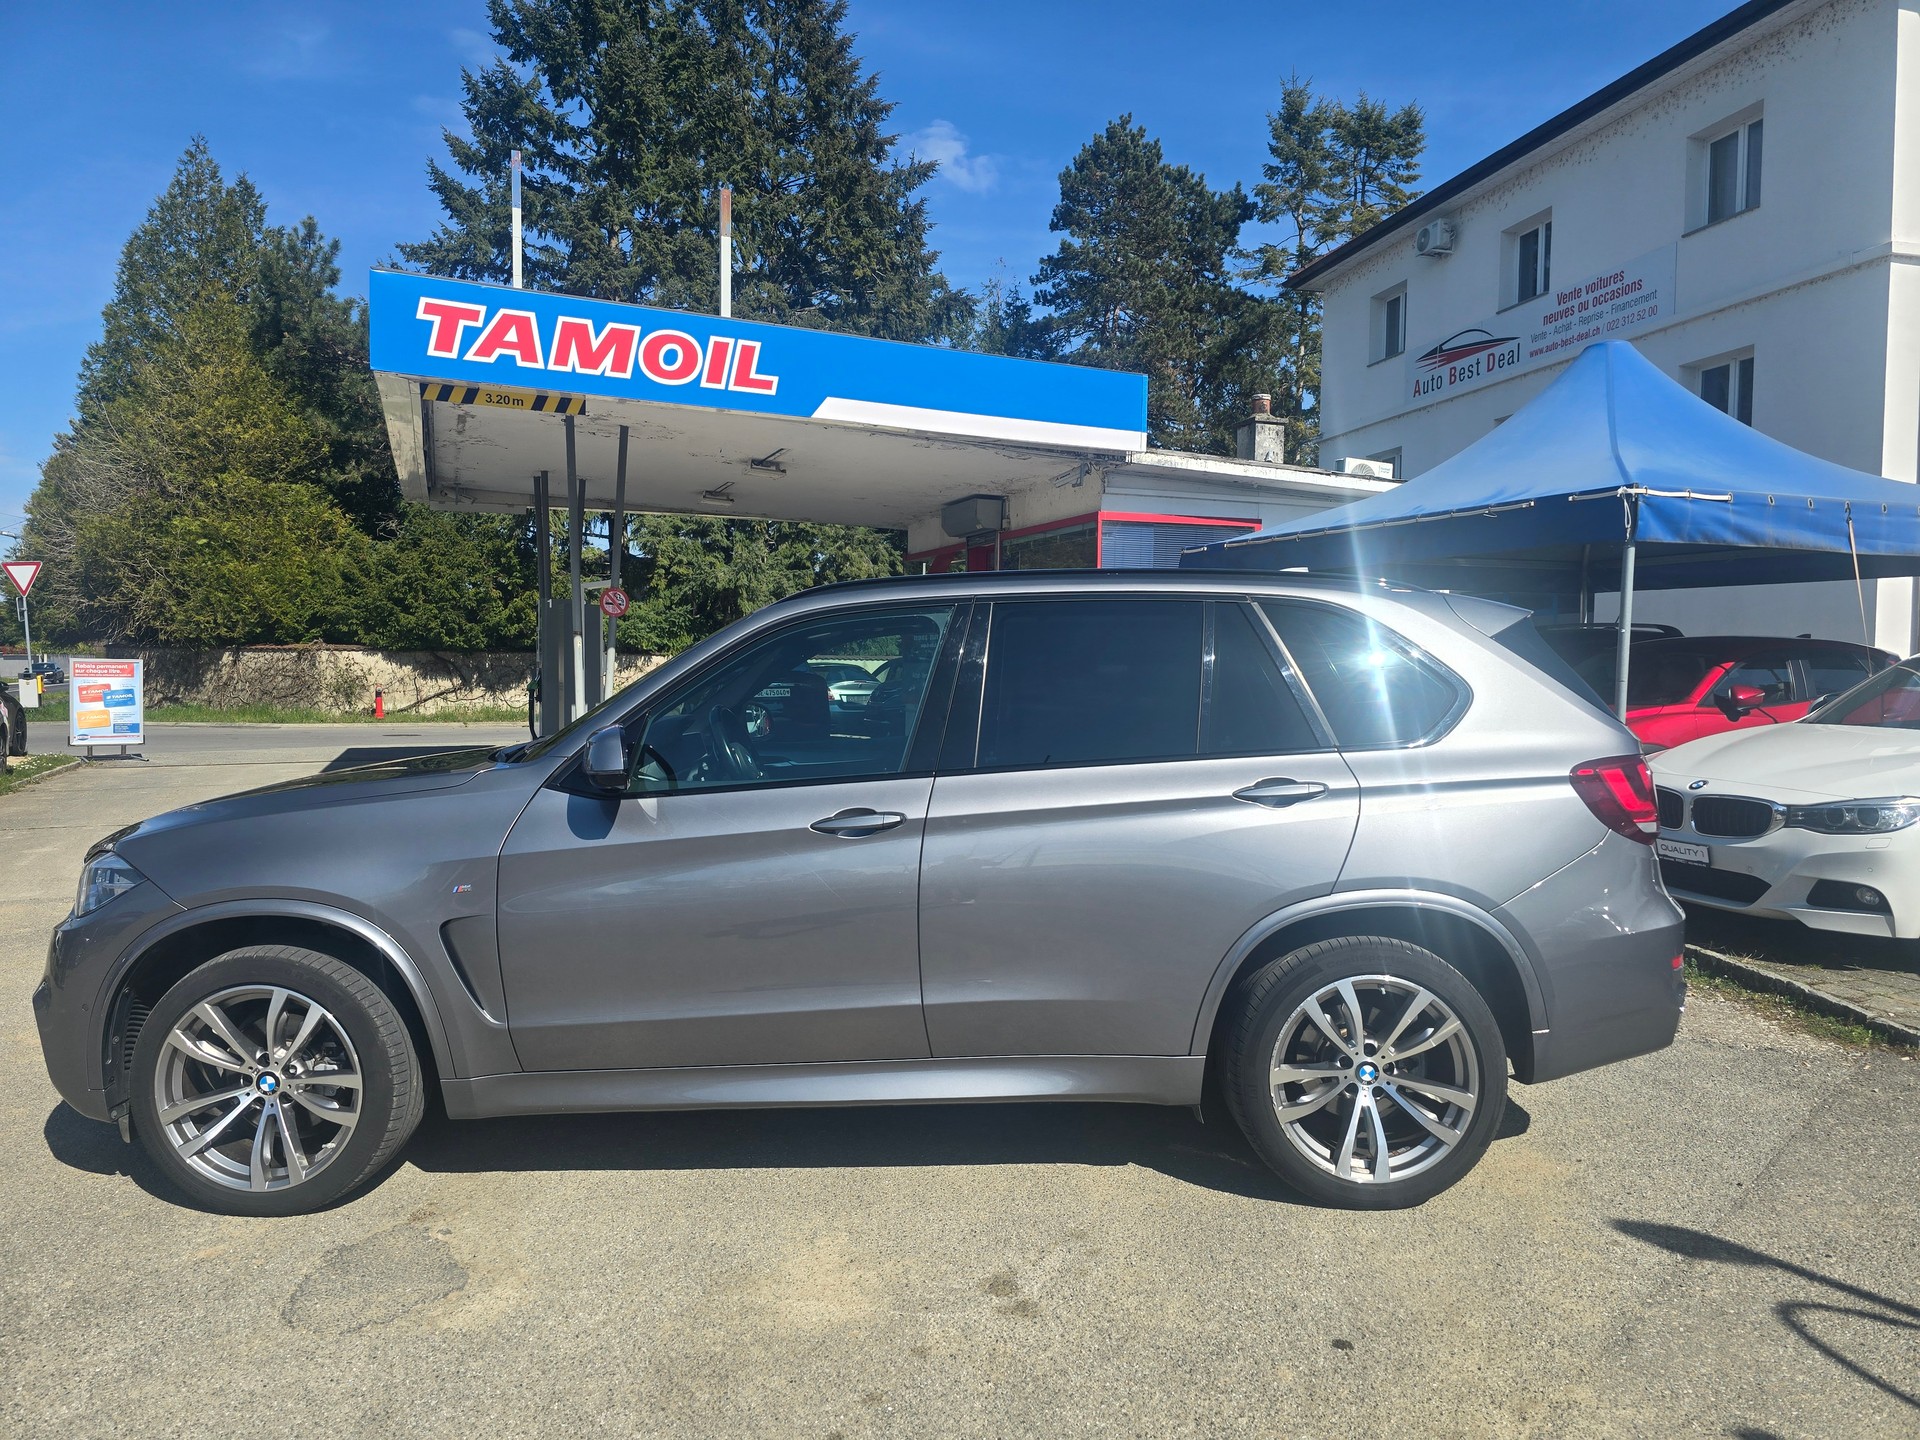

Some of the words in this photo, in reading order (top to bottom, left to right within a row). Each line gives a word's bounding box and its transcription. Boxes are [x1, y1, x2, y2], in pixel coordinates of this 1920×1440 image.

[1543, 305, 1575, 326] neuves
[1577, 299, 1589, 313] ou
[1592, 278, 1643, 308] occasions
[1556, 286, 1582, 306] Vente
[1585, 270, 1625, 296] voitures
[1529, 325, 1601, 358] www.auto-best-deal.ch
[1606, 318, 1620, 332] 022
[1621, 312, 1635, 327] 312
[1636, 308, 1647, 321] 52
[1648, 304, 1658, 317] 00
[1530, 330, 1548, 344] Vente
[1552, 321, 1573, 336] Achat
[1578, 310, 1604, 327] Reprise
[1610, 288, 1658, 315] Financement
[415, 296, 780, 397] TAMOIL
[1413, 374, 1443, 398] Auto
[1449, 358, 1481, 386] Best
[1486, 342, 1520, 373] Deal
[485, 393, 510, 405] 3.20
[1660, 843, 1699, 857] QUALITY
